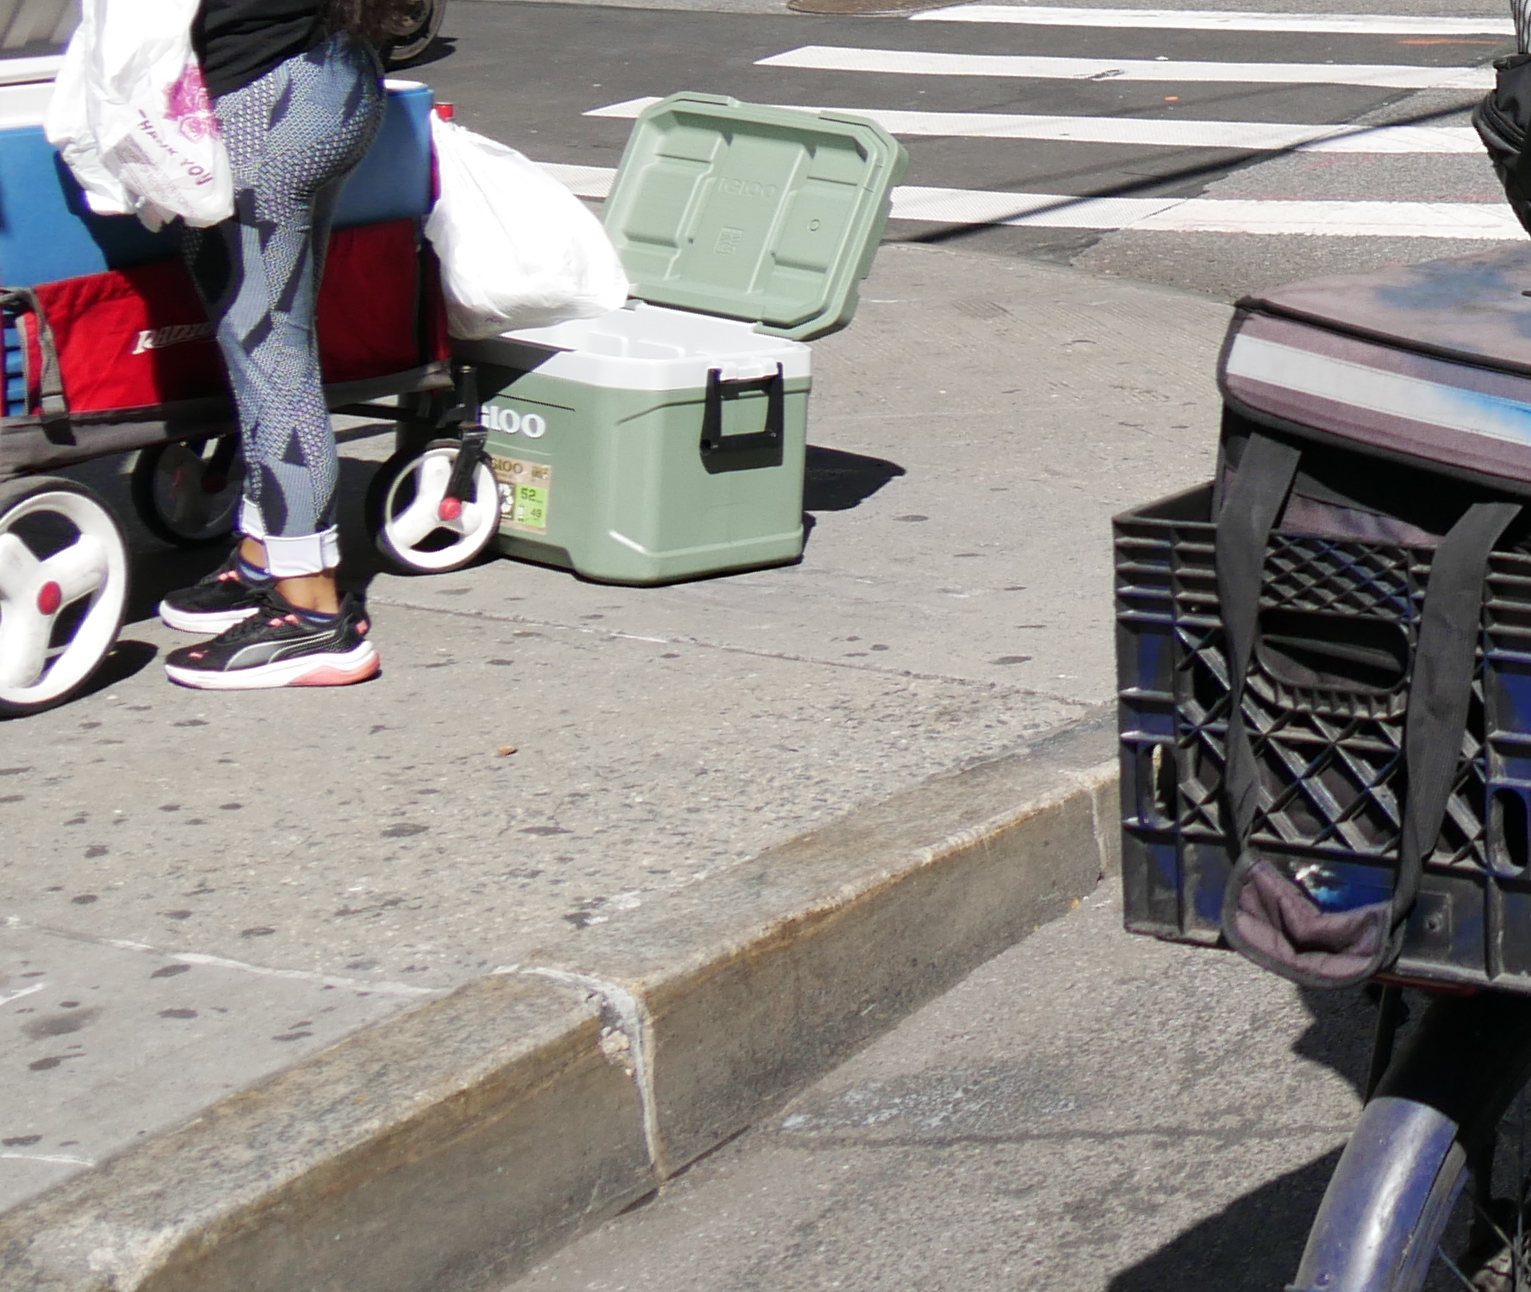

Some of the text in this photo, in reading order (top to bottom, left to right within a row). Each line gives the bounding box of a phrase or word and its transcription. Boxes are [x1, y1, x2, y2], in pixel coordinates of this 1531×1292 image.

[717, 176, 779, 199] IGLOO
[491, 458, 523, 474] GLOO
[520, 487, 536, 501] 52
